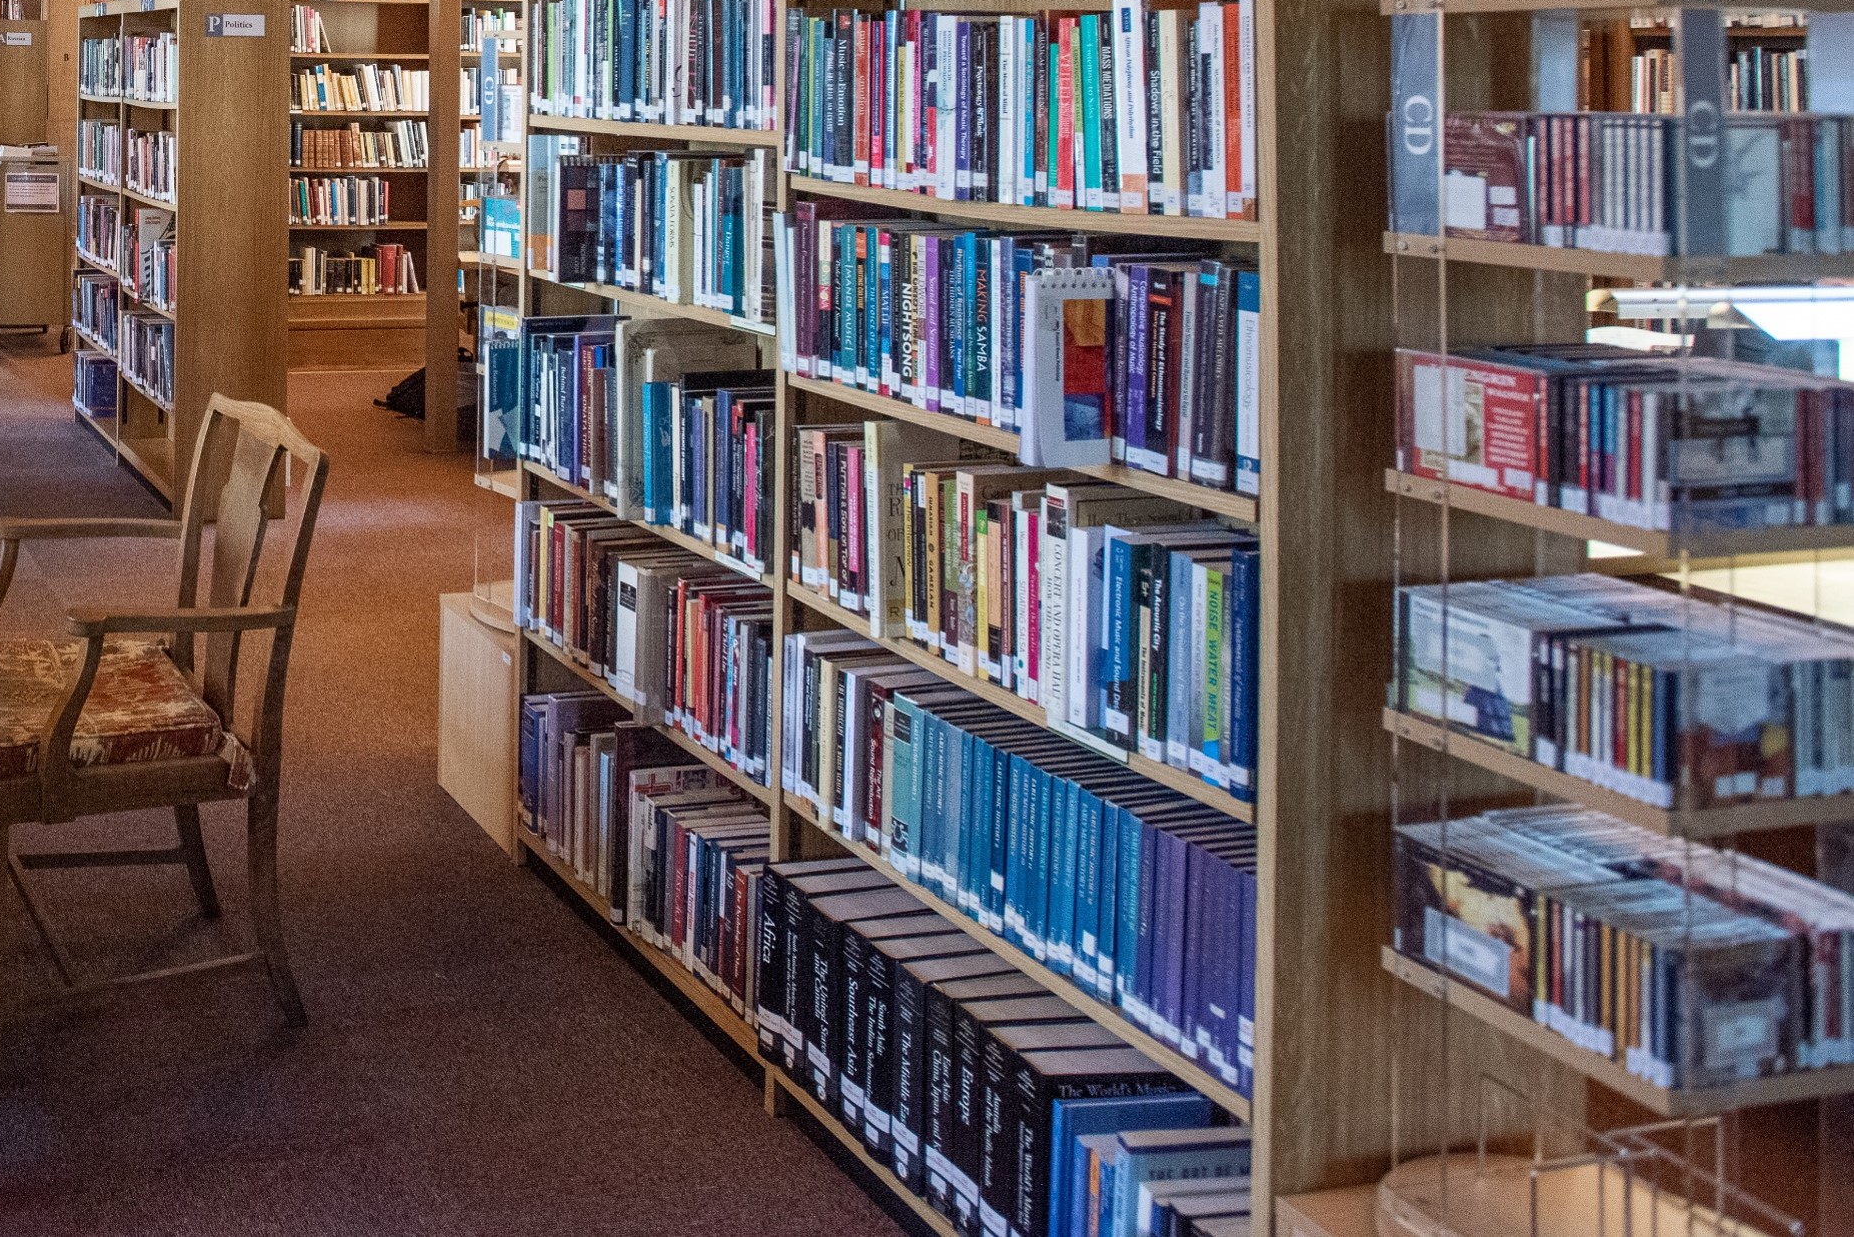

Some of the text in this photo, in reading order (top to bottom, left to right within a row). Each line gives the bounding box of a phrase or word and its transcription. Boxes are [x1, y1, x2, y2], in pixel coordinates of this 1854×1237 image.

[208, 17, 253, 33] P Politics
[838, 39, 847, 70] Music
[1125, 36, 1133, 57] African
[484, 76, 494, 105] CD
[960, 67, 968, 99] Sociology
[976, 66, 984, 106] Psychology
[1102, 46, 1113, 120] MASS MEDIATIONS
[1125, 59, 1133, 91] Polyphony
[838, 83, 847, 126] Emotion
[1151, 71, 1162, 174] Shadows in the Field
[976, 117, 984, 138] Music
[1403, 95, 1436, 156] CD
[960, 132, 968, 160] Therapy
[724, 231, 732, 266] Danger
[845, 267, 853, 345] MANDE MUSIC
[957, 286, 963, 296] of
[902, 283, 912, 377] NIGHTSONG
[929, 276, 938, 371] Sound and Sentiment
[977, 270, 987, 372] MAKING SAMBA
[1129, 285, 1138, 373] Anthropology of Music
[1136, 281, 1147, 376] Comparative Musicology
[1155, 311, 1166, 431] The Study of Ethnomusicology
[1242, 320, 1256, 411] Ethnomusicology
[1114, 576, 1123, 617] Electronic
[1152, 579, 1163, 652] The Acoustic City
[1114, 619, 1123, 643] Music
[1113, 645, 1122, 662] and
[1207, 590, 1220, 731] NOISE WATER MEAT
[1113, 664, 1122, 691] Sound
[762, 913, 777, 965] Africa
[820, 959, 829, 979] The
[814, 973, 823, 1019] Canada
[819, 983, 829, 1021] United
[868, 995, 876, 1013] The
[878, 1001, 887, 1027] South
[847, 977, 858, 1076] Southeast Asia
[867, 1017, 876, 1046] Indian
[900, 1032, 912, 1126] The Middle Eas
[943, 1057, 951, 1077] East
[931, 1050, 943, 1141] China, Japan, and
[960, 1066, 973, 1125] Europe
[993, 1094, 1002, 1134] Australia
[1024, 1128, 1034, 1149] The
